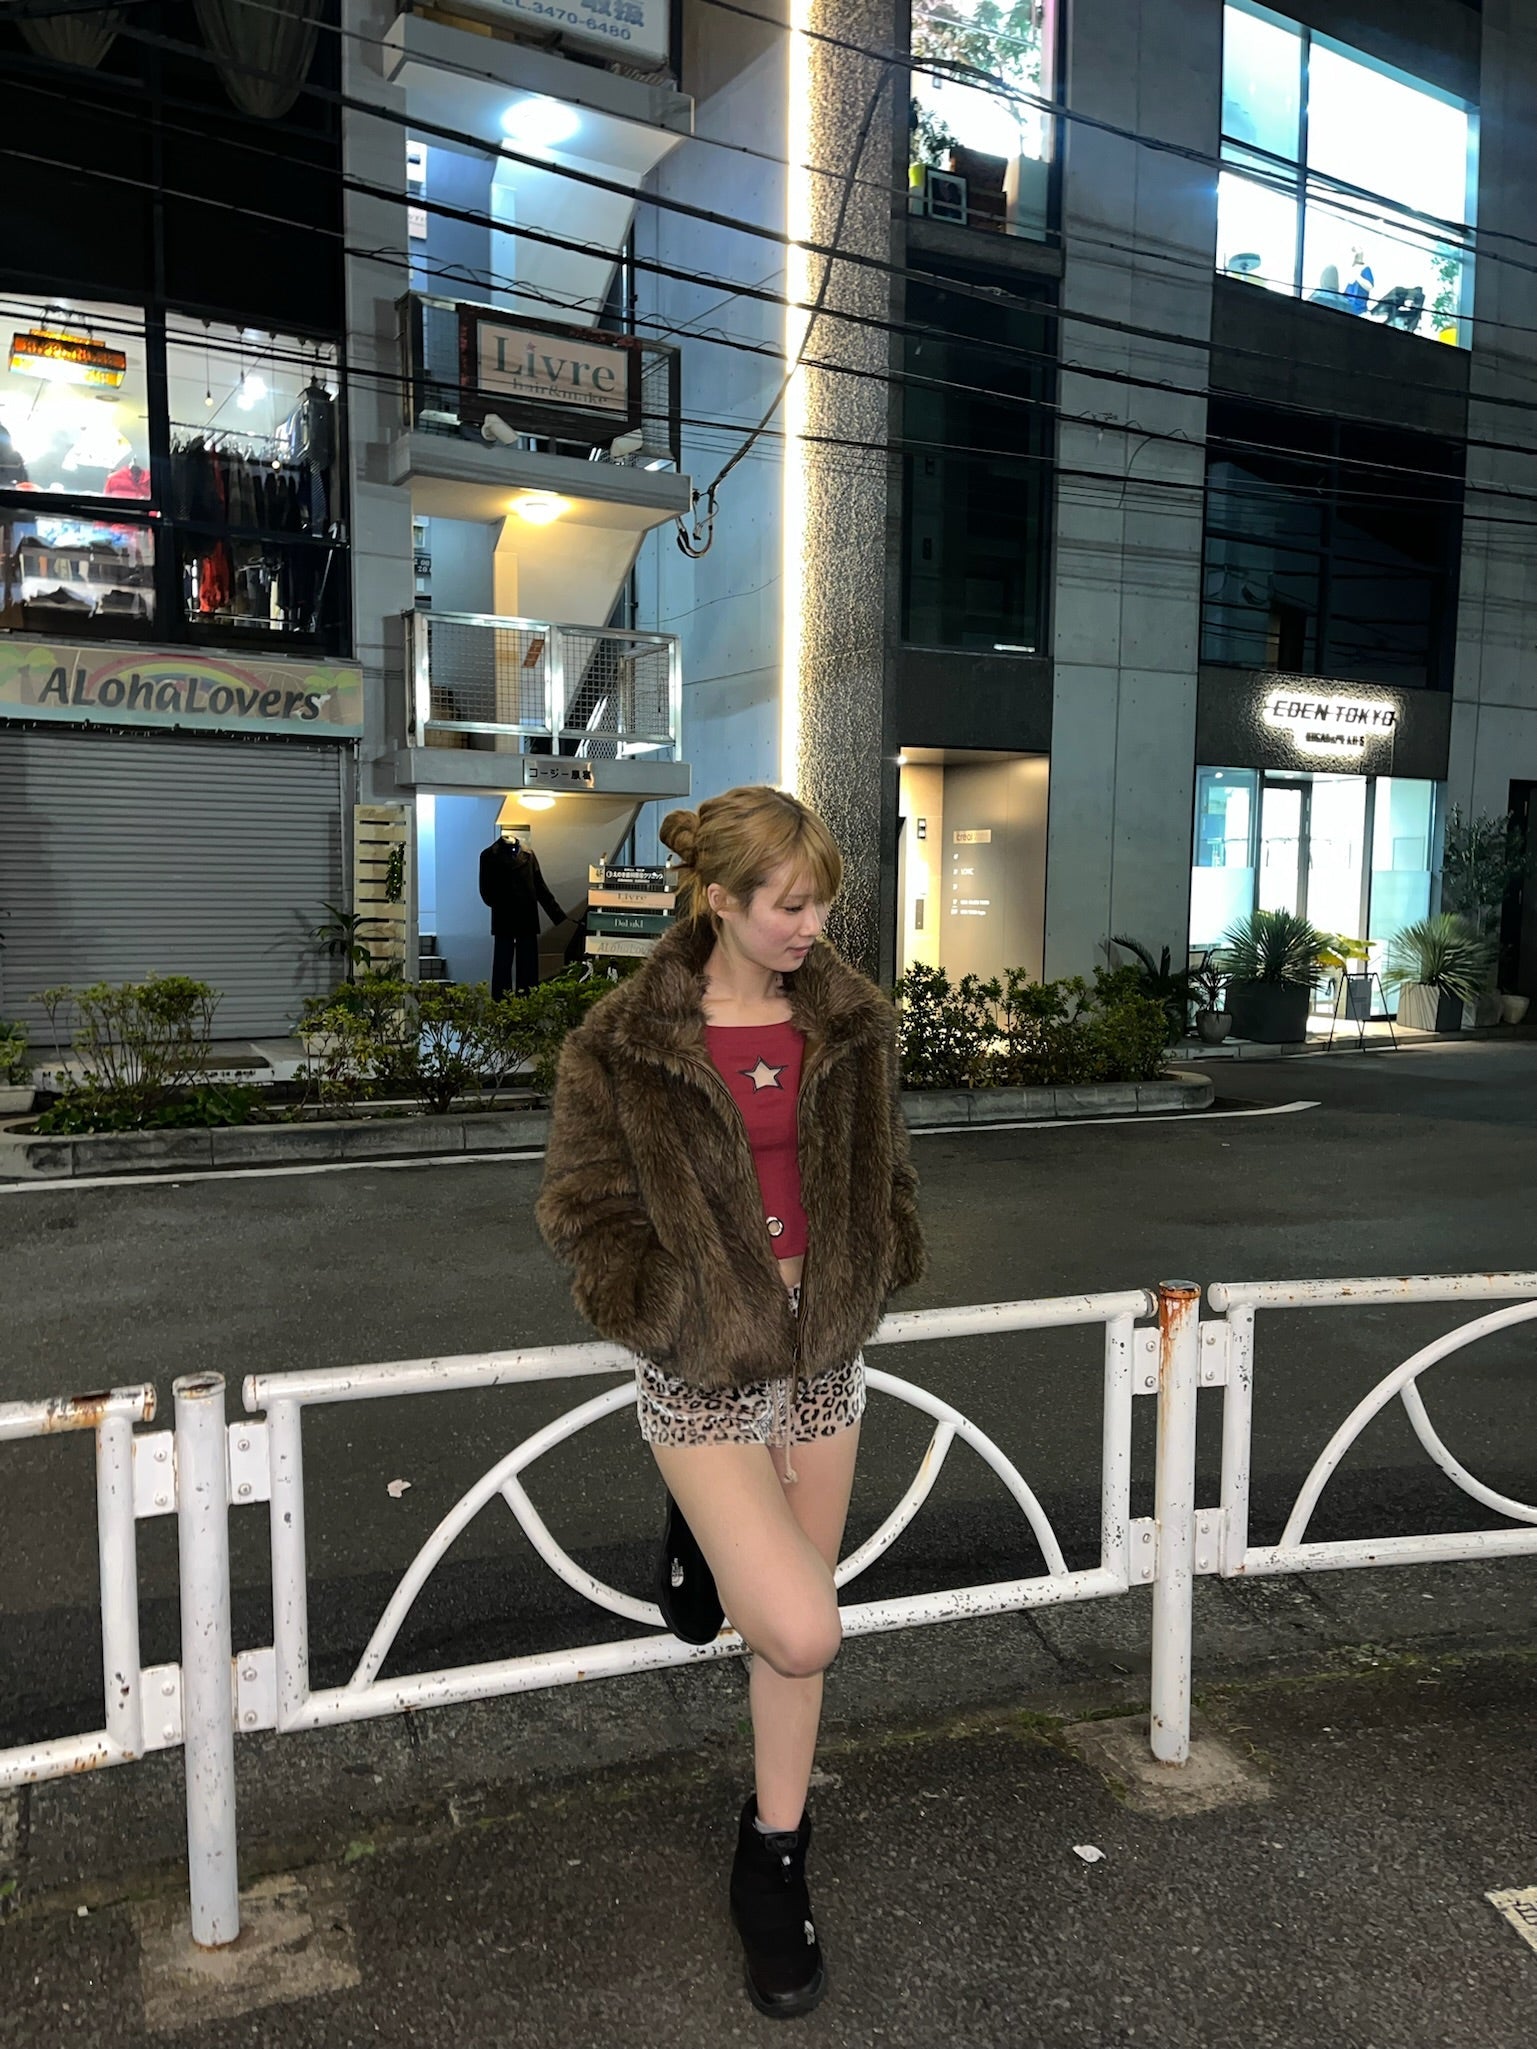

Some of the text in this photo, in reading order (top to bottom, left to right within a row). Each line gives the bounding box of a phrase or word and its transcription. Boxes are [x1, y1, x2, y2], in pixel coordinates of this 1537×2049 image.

[493, 335, 616, 392] Livre
[38, 665, 321, 720] ALohaLovers
[1272, 700, 1396, 727] EDEN TOKYO
